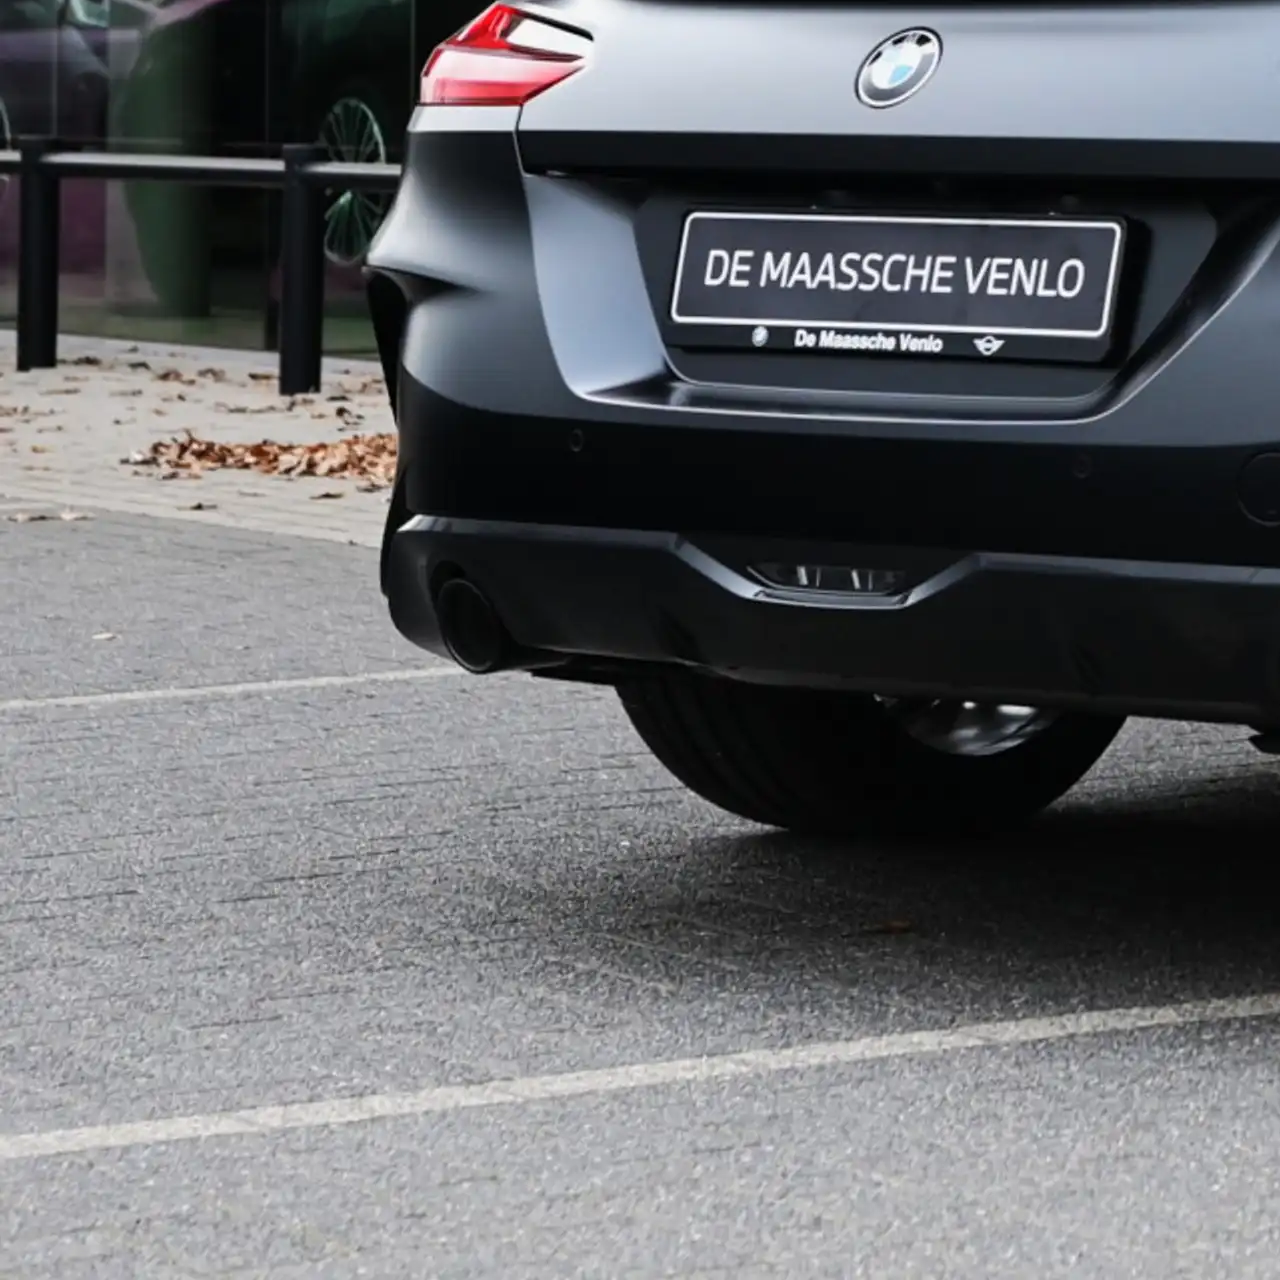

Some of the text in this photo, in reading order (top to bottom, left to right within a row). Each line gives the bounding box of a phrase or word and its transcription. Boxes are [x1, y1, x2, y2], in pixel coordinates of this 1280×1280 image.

[704, 249, 1086, 298] DE MAASSCHE VENLO
[794, 328, 944, 353] De Maassche Venlo
